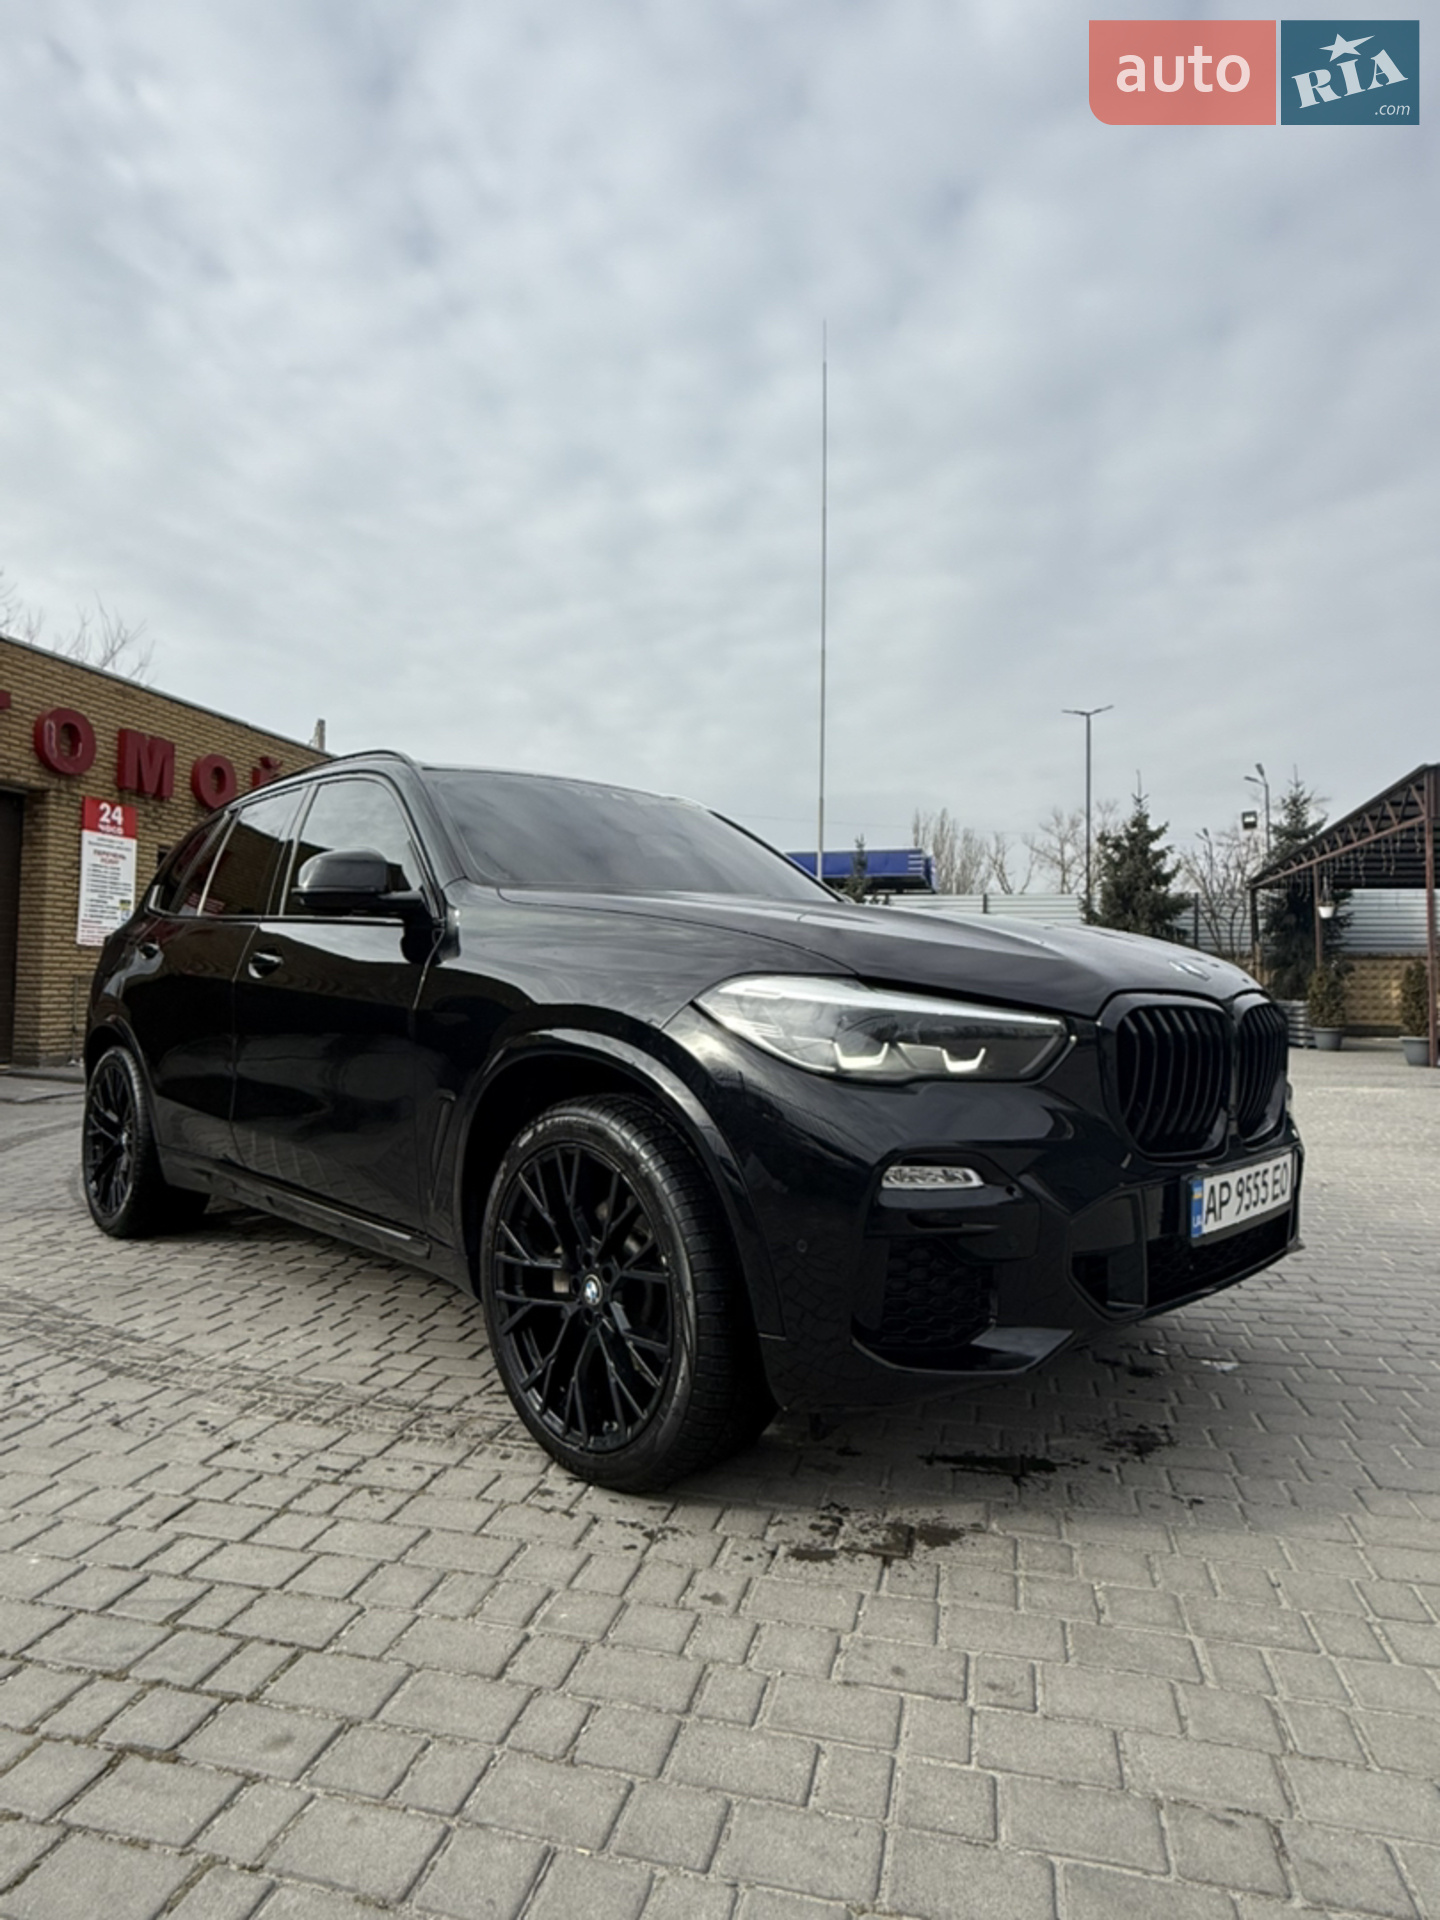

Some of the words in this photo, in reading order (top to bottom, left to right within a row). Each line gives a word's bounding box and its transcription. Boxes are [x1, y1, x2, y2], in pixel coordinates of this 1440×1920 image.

[98, 802, 124, 826] 24
[1204, 1180, 1232, 1225] AP
[1235, 1167, 1270, 1217] 9555
[1271, 1161, 1289, 1202] EO
